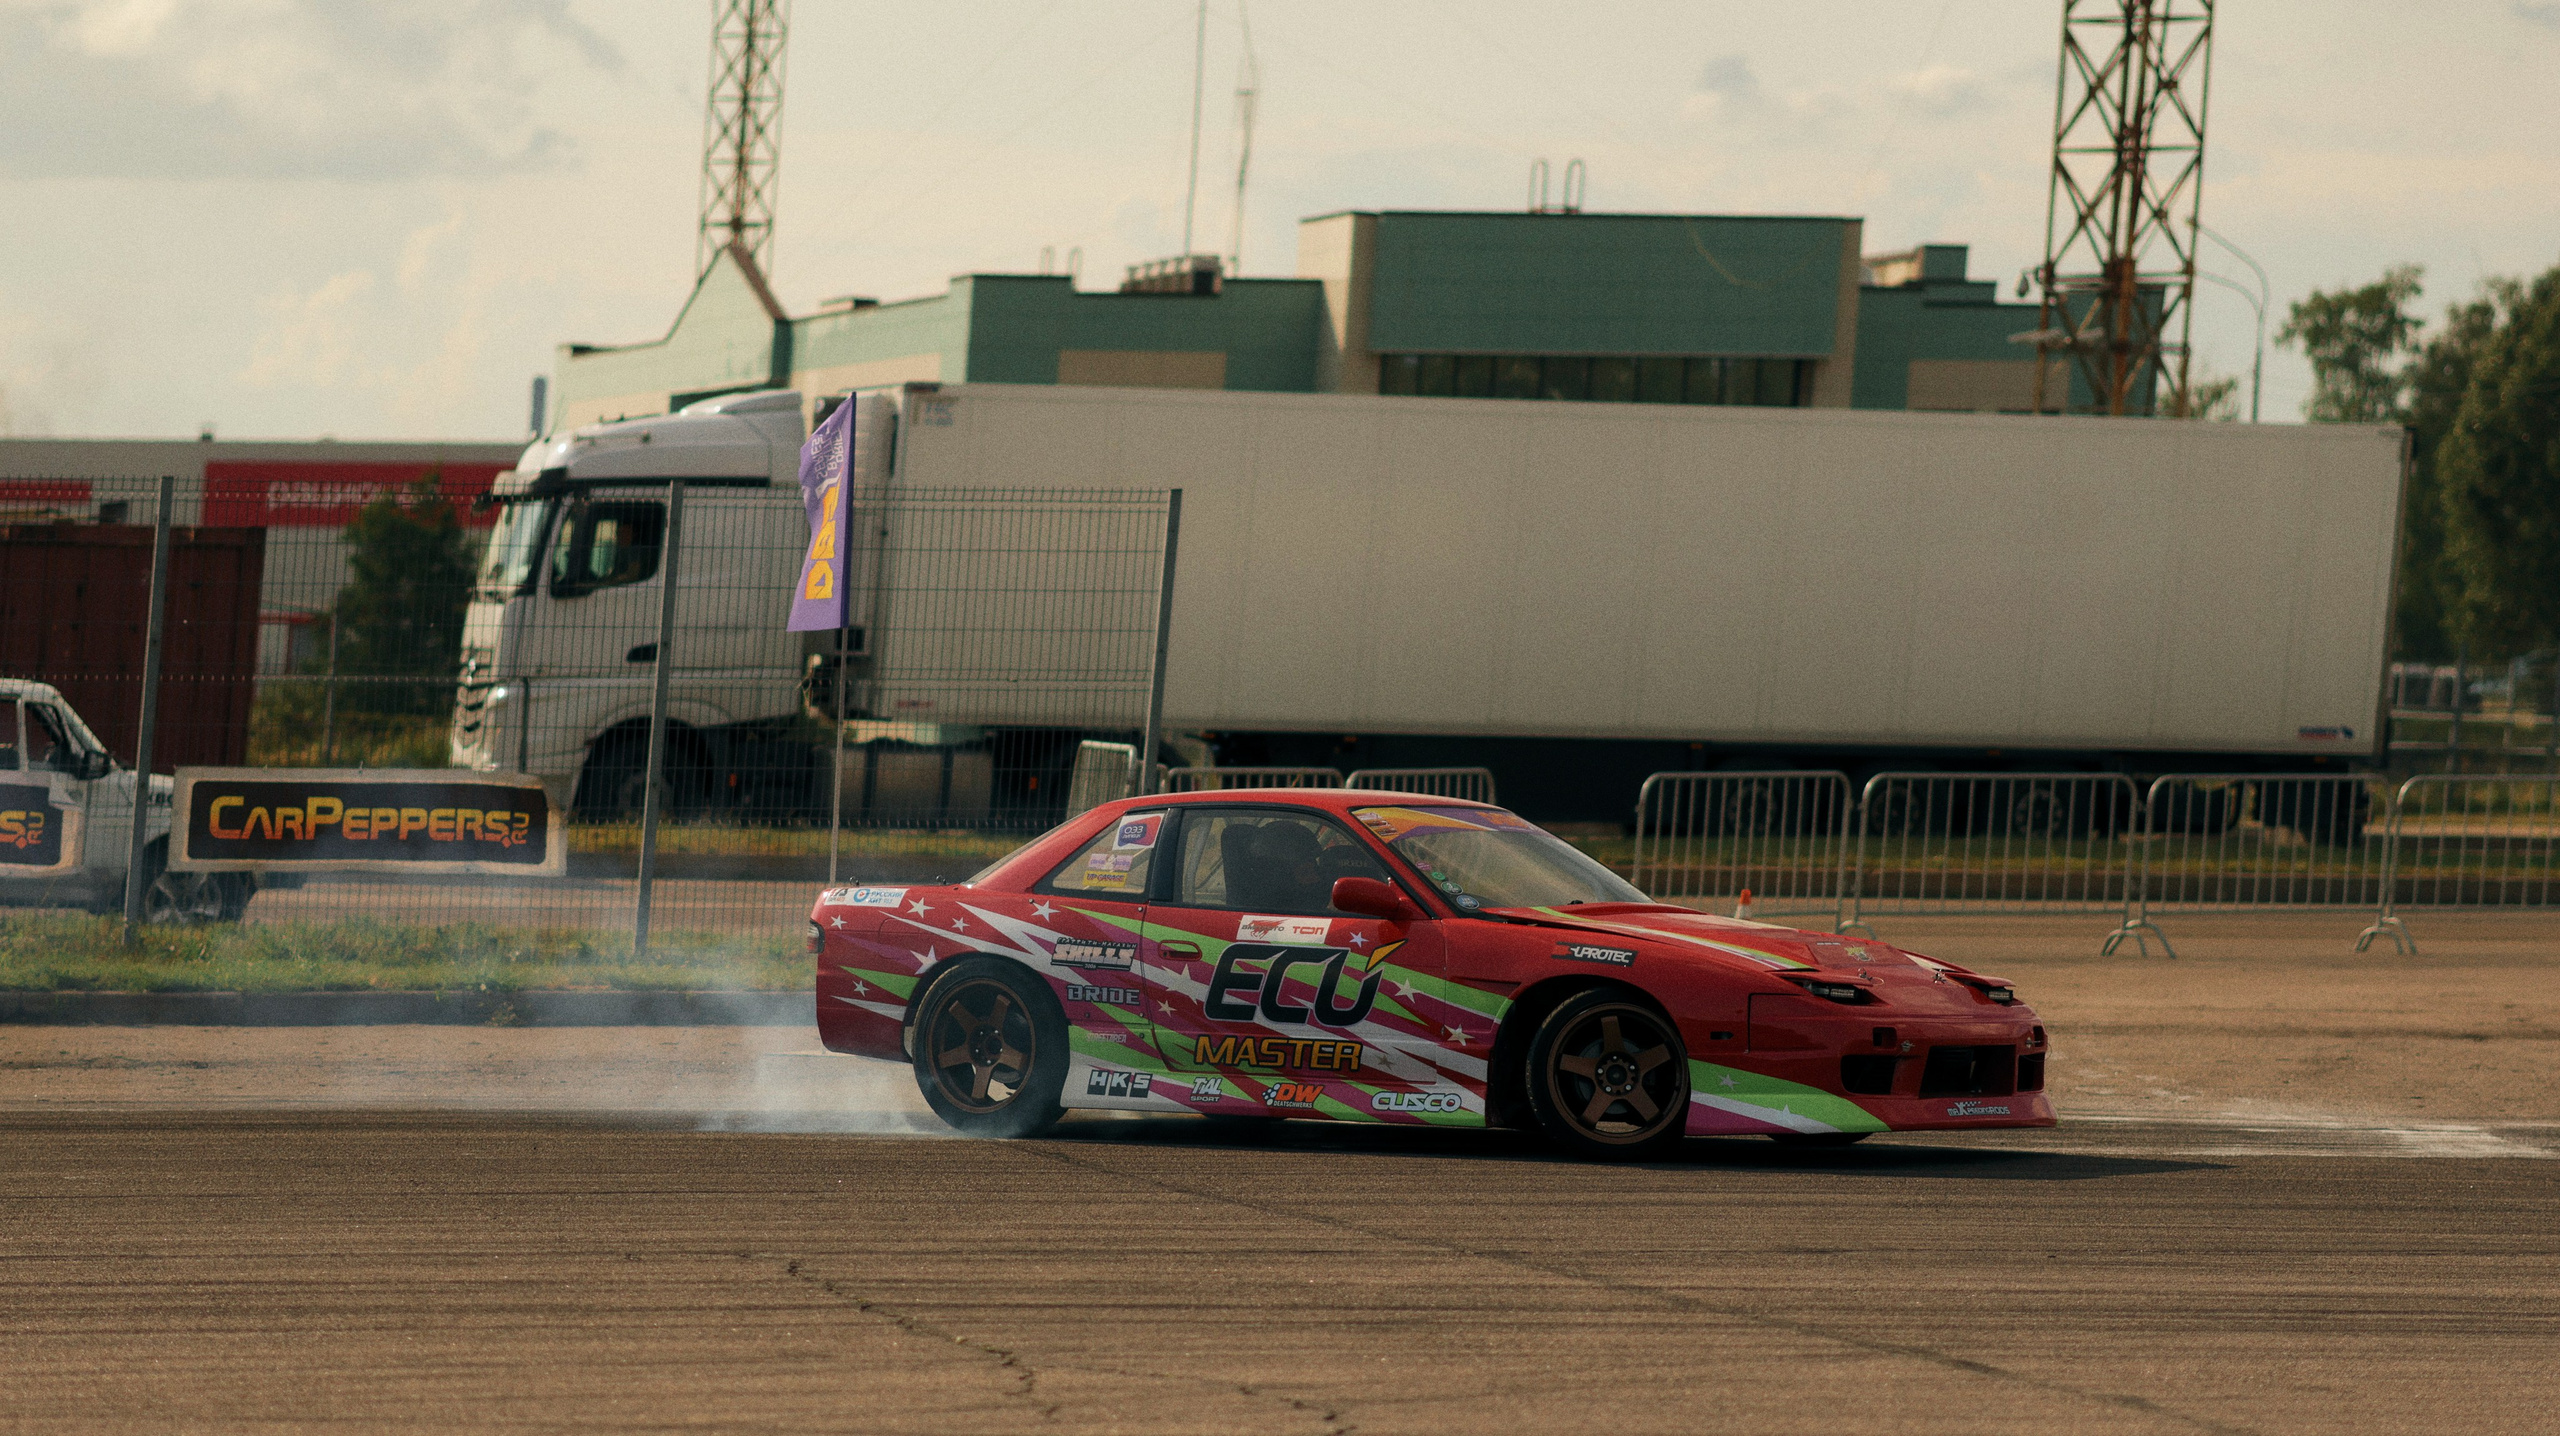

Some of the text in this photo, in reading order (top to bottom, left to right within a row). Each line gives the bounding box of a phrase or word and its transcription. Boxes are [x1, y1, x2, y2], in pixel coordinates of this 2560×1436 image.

[1052, 944, 1137, 966] SKILLS
[1066, 984, 1140, 1005] BRIDE
[1203, 942, 1386, 1027] ECU
[1194, 1034, 1363, 1072] MASTER
[1090, 1069, 1152, 1093] HKS
[1190, 1095, 1220, 1103] SPORT
[1275, 1083, 1324, 1101] DW
[1371, 1091, 1462, 1112] CUSCO
[1273, 1100, 1313, 1109] DEATSCHWERKS
